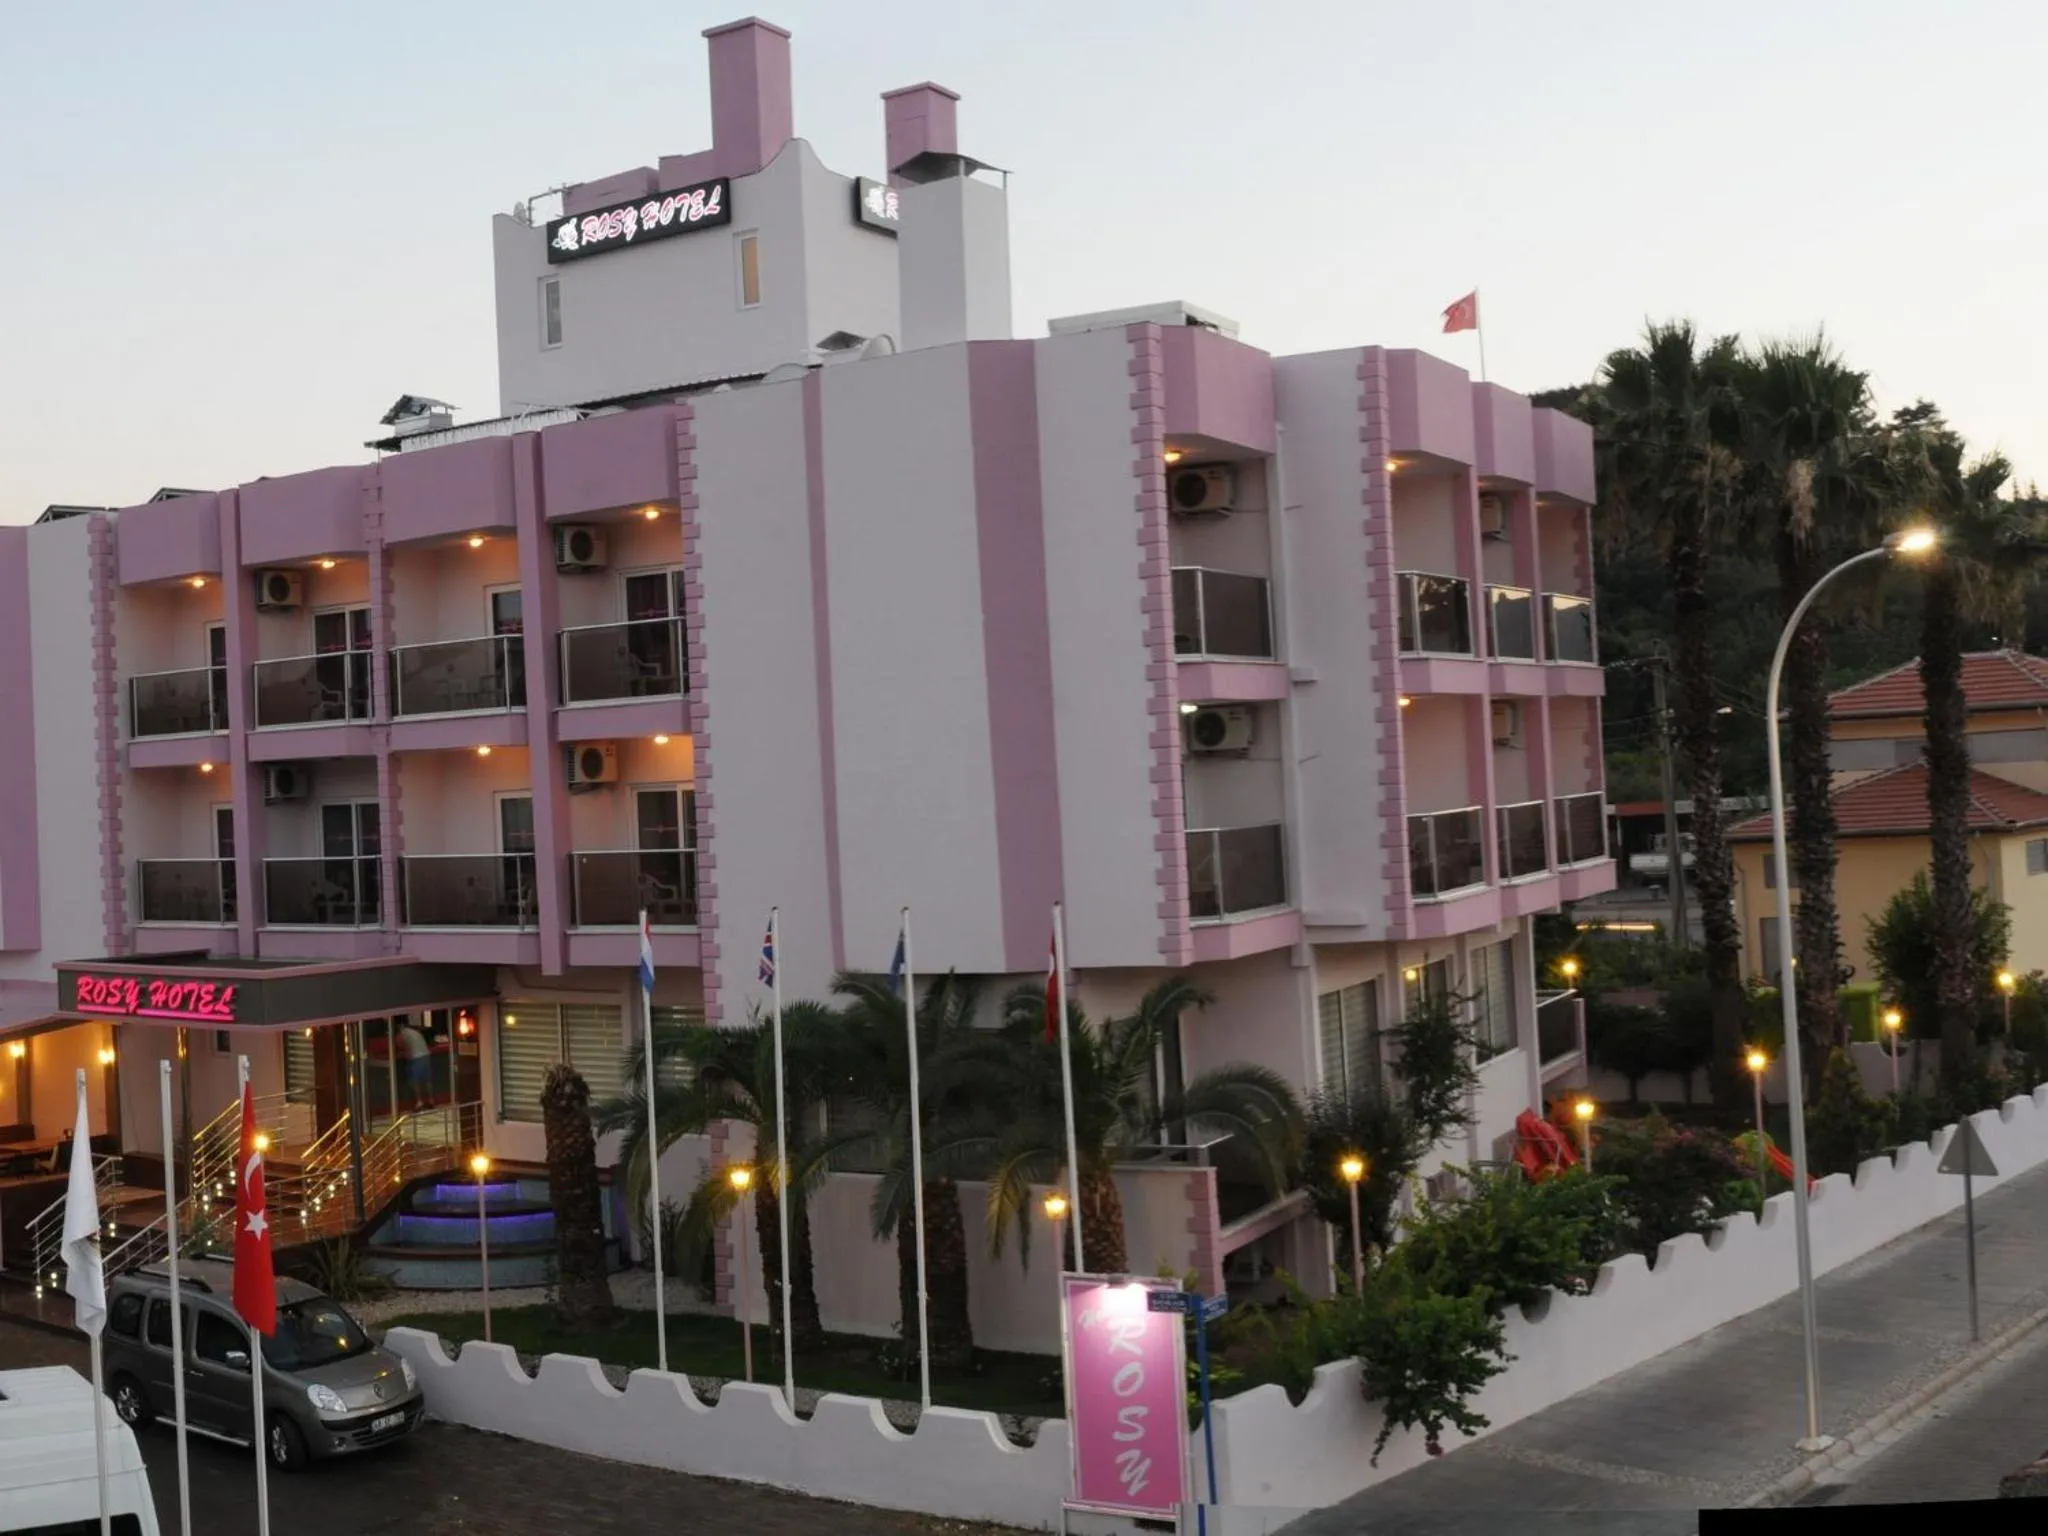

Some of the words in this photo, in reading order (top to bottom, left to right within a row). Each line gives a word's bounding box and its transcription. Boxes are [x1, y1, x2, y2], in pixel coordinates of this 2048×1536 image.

[580, 206, 638, 246] ROSY
[640, 184, 722, 231] HOTEL
[76, 975, 139, 1013] ROSY
[149, 980, 235, 1014] HOTEL
[1107, 1317, 1153, 1498] ROSY
